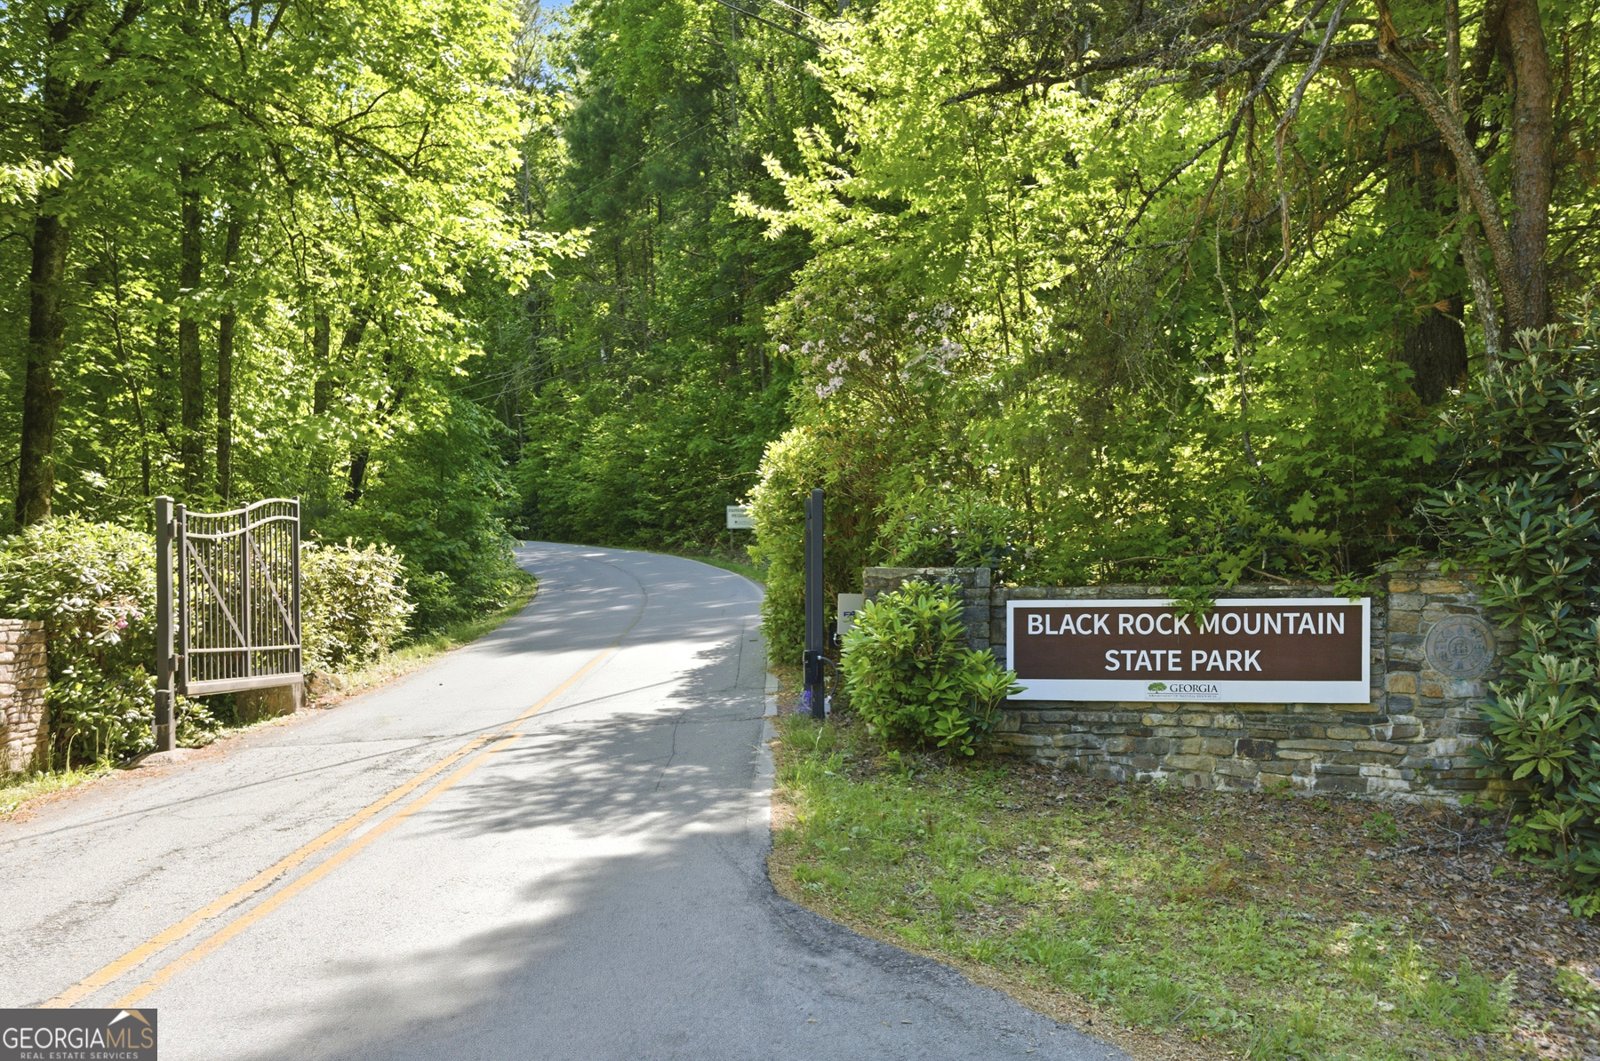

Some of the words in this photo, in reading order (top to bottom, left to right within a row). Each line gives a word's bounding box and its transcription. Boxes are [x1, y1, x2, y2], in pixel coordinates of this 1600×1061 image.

[1027, 613, 1111, 635] BLACK
[1118, 613, 1192, 635] ROCK
[1199, 612, 1345, 635] MOUNTAIN
[1104, 649, 1183, 672] STATE
[1191, 649, 1263, 672] PARK
[1169, 683, 1218, 693] GEORGIA
